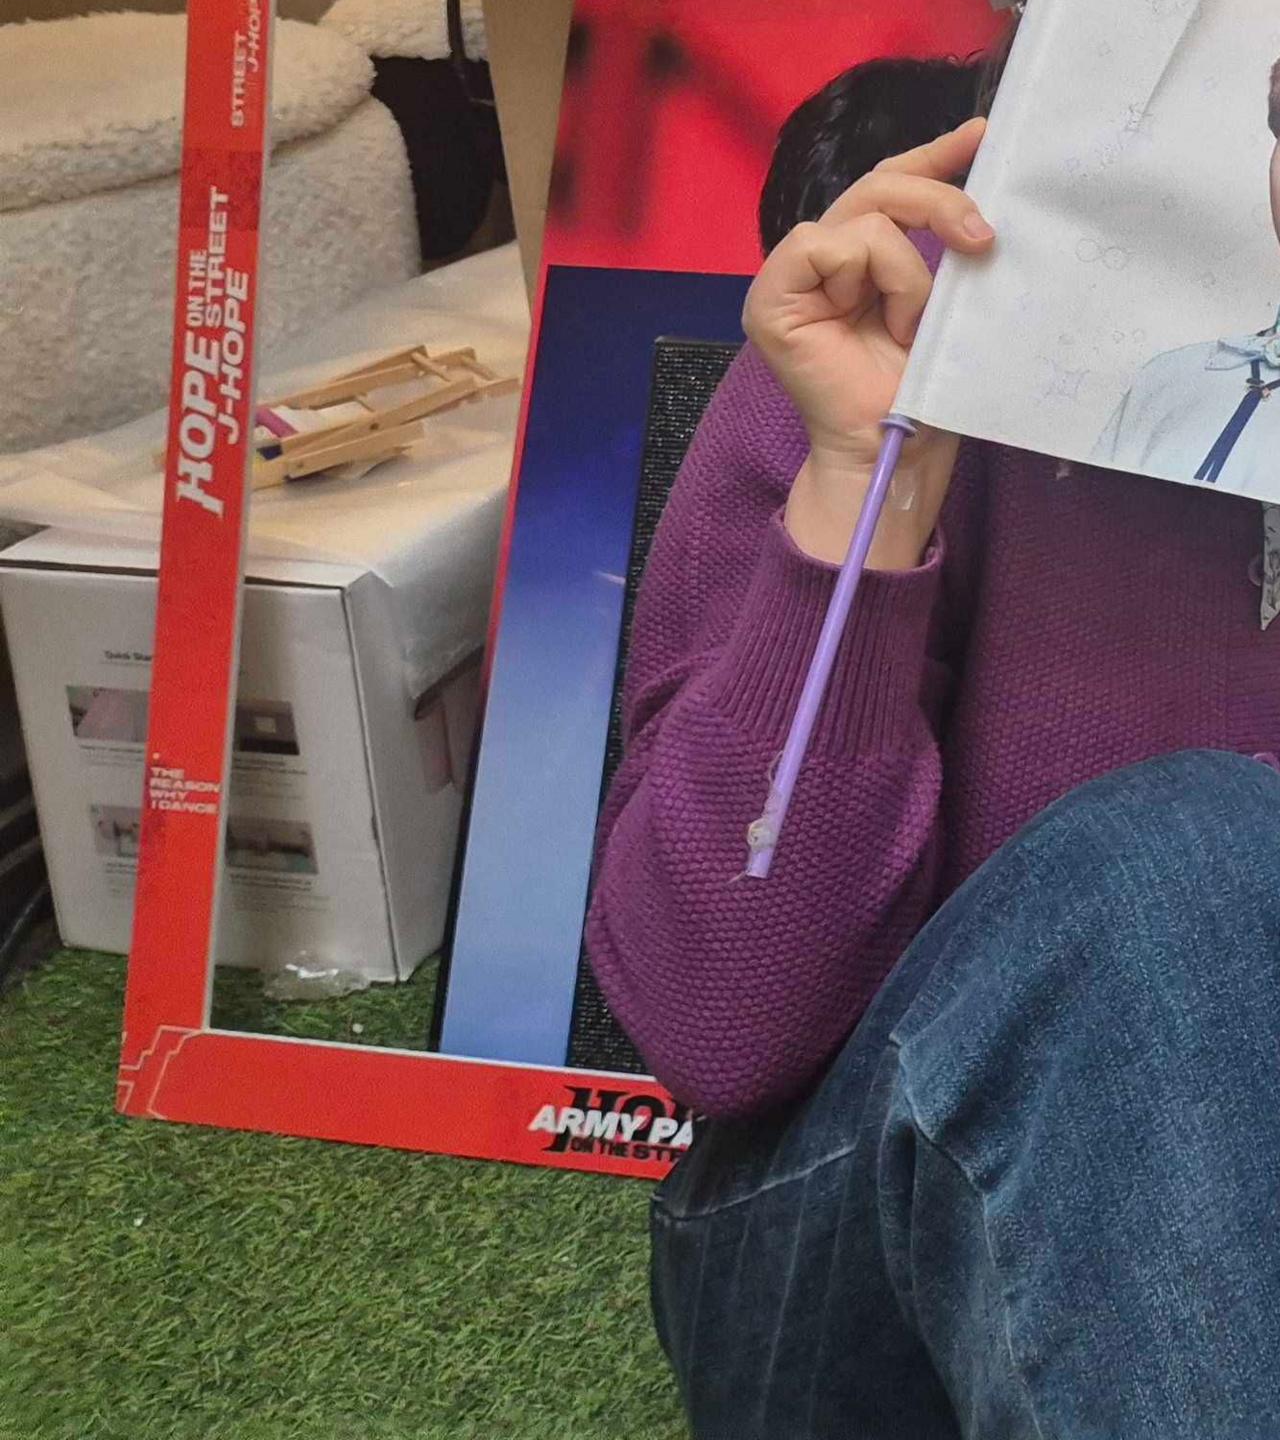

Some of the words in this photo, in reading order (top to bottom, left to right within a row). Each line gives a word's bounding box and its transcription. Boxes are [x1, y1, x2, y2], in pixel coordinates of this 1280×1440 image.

[230, 30, 248, 128] STREET
[189, 249, 206, 293] THE
[206, 185, 231, 330] STREET
[188, 298, 204, 328] ON
[219, 268, 249, 445] J-HOPE
[176, 332, 225, 517] HOPE
[150, 777, 222, 793] REASON
[151, 767, 185, 778] THE
[150, 789, 188, 801] WHY
[158, 800, 218, 815] DANCE
[527, 1104, 648, 1142] ARMY
